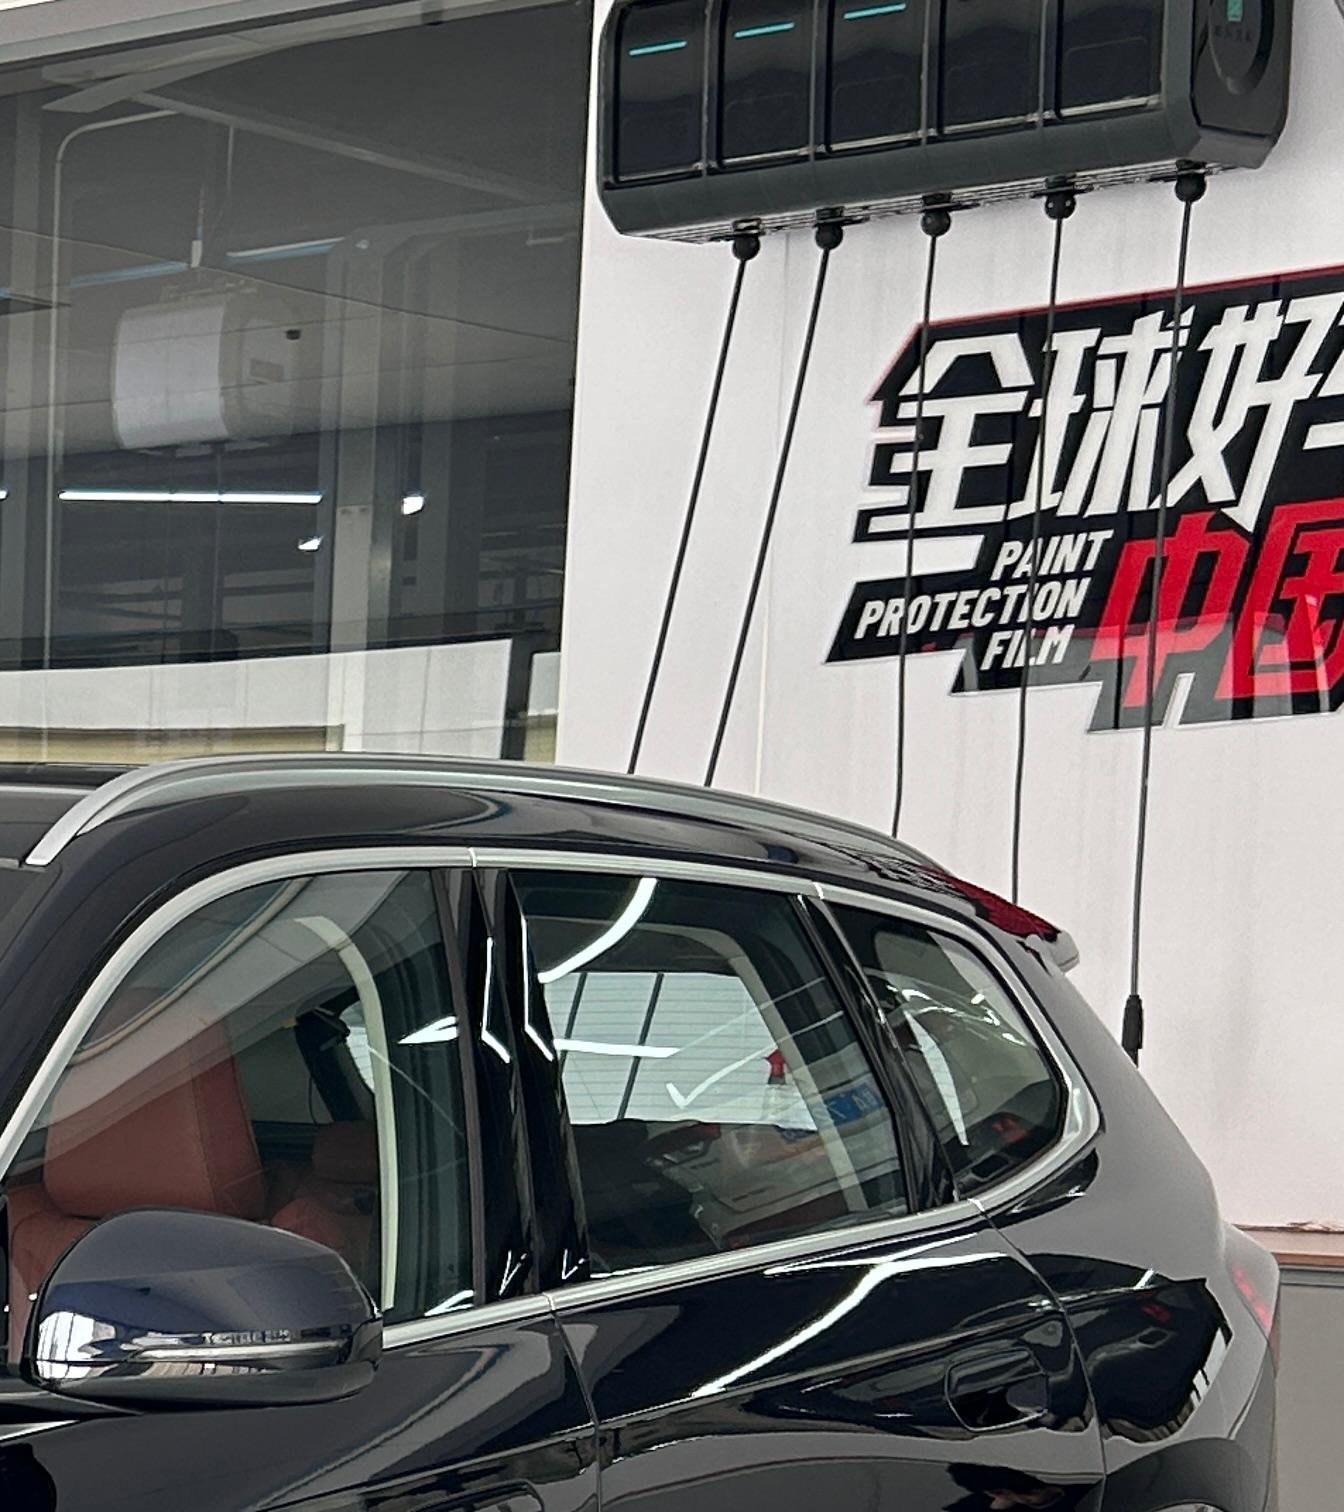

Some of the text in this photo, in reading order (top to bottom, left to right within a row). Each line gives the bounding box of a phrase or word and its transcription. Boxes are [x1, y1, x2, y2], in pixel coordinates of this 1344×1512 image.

[868, 292, 1344, 534] 全球好
[853, 577, 1092, 640] PROTECTION
[990, 529, 1114, 581] PAINT
[1089, 498, 1344, 709] 中国
